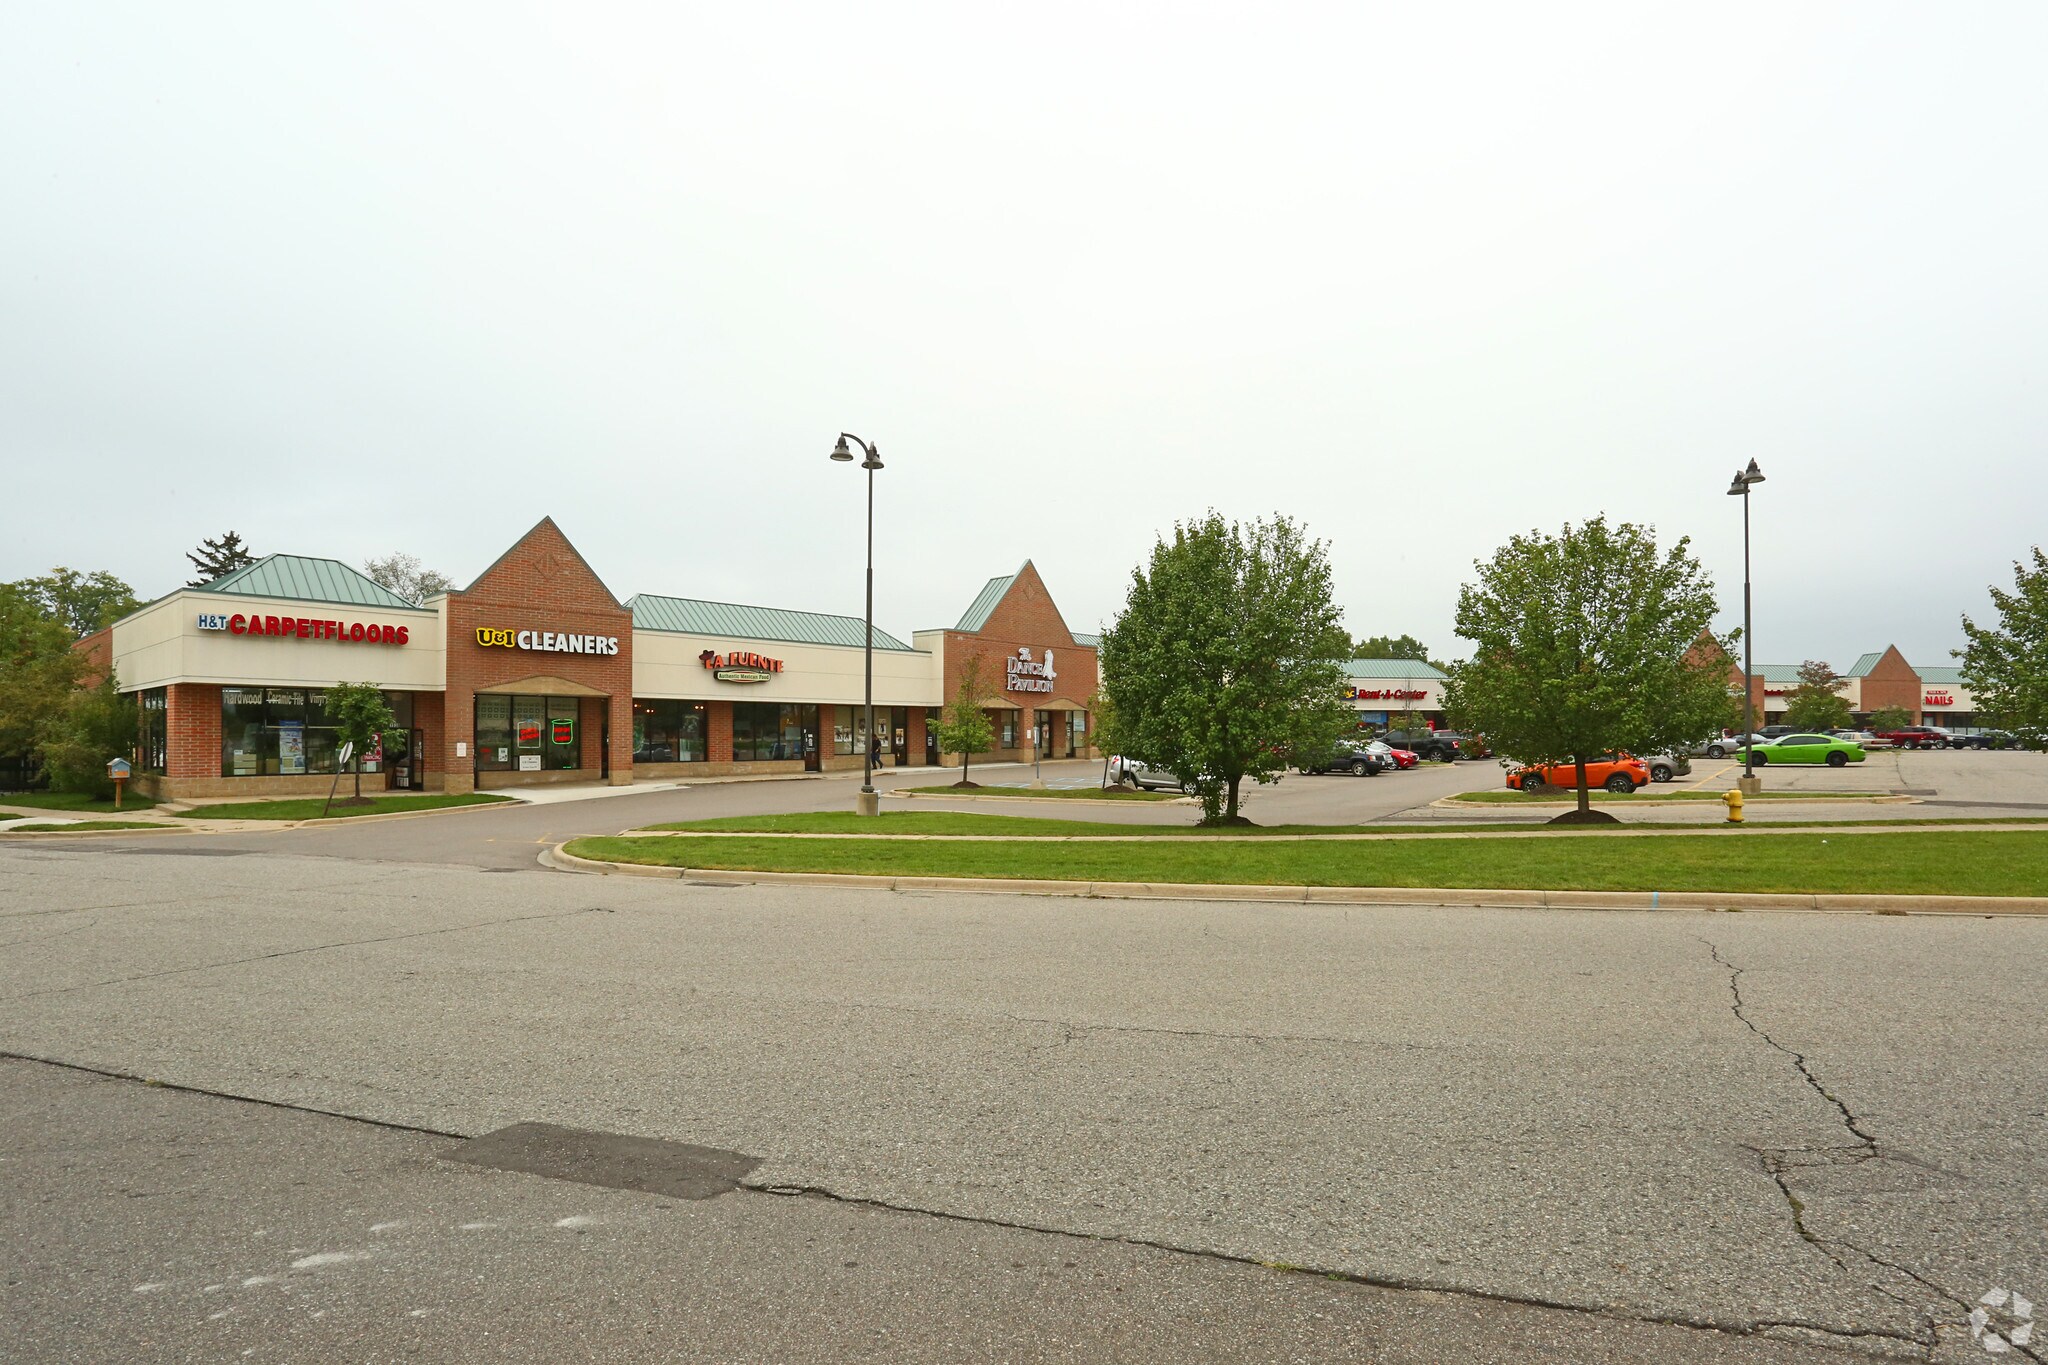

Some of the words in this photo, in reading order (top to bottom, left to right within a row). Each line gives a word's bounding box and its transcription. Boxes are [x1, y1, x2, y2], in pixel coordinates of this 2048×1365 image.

[198, 614, 227, 629] H&T
[230, 614, 409, 645] CARPETFLOORS
[517, 630, 619, 655] CLEANERS
[705, 655, 725, 669] LA
[729, 651, 784, 673] FUENTE
[223, 691, 262, 705] Hardwood
[267, 690, 292, 705] Ceramic
[1925, 695, 1954, 705] NAILS
